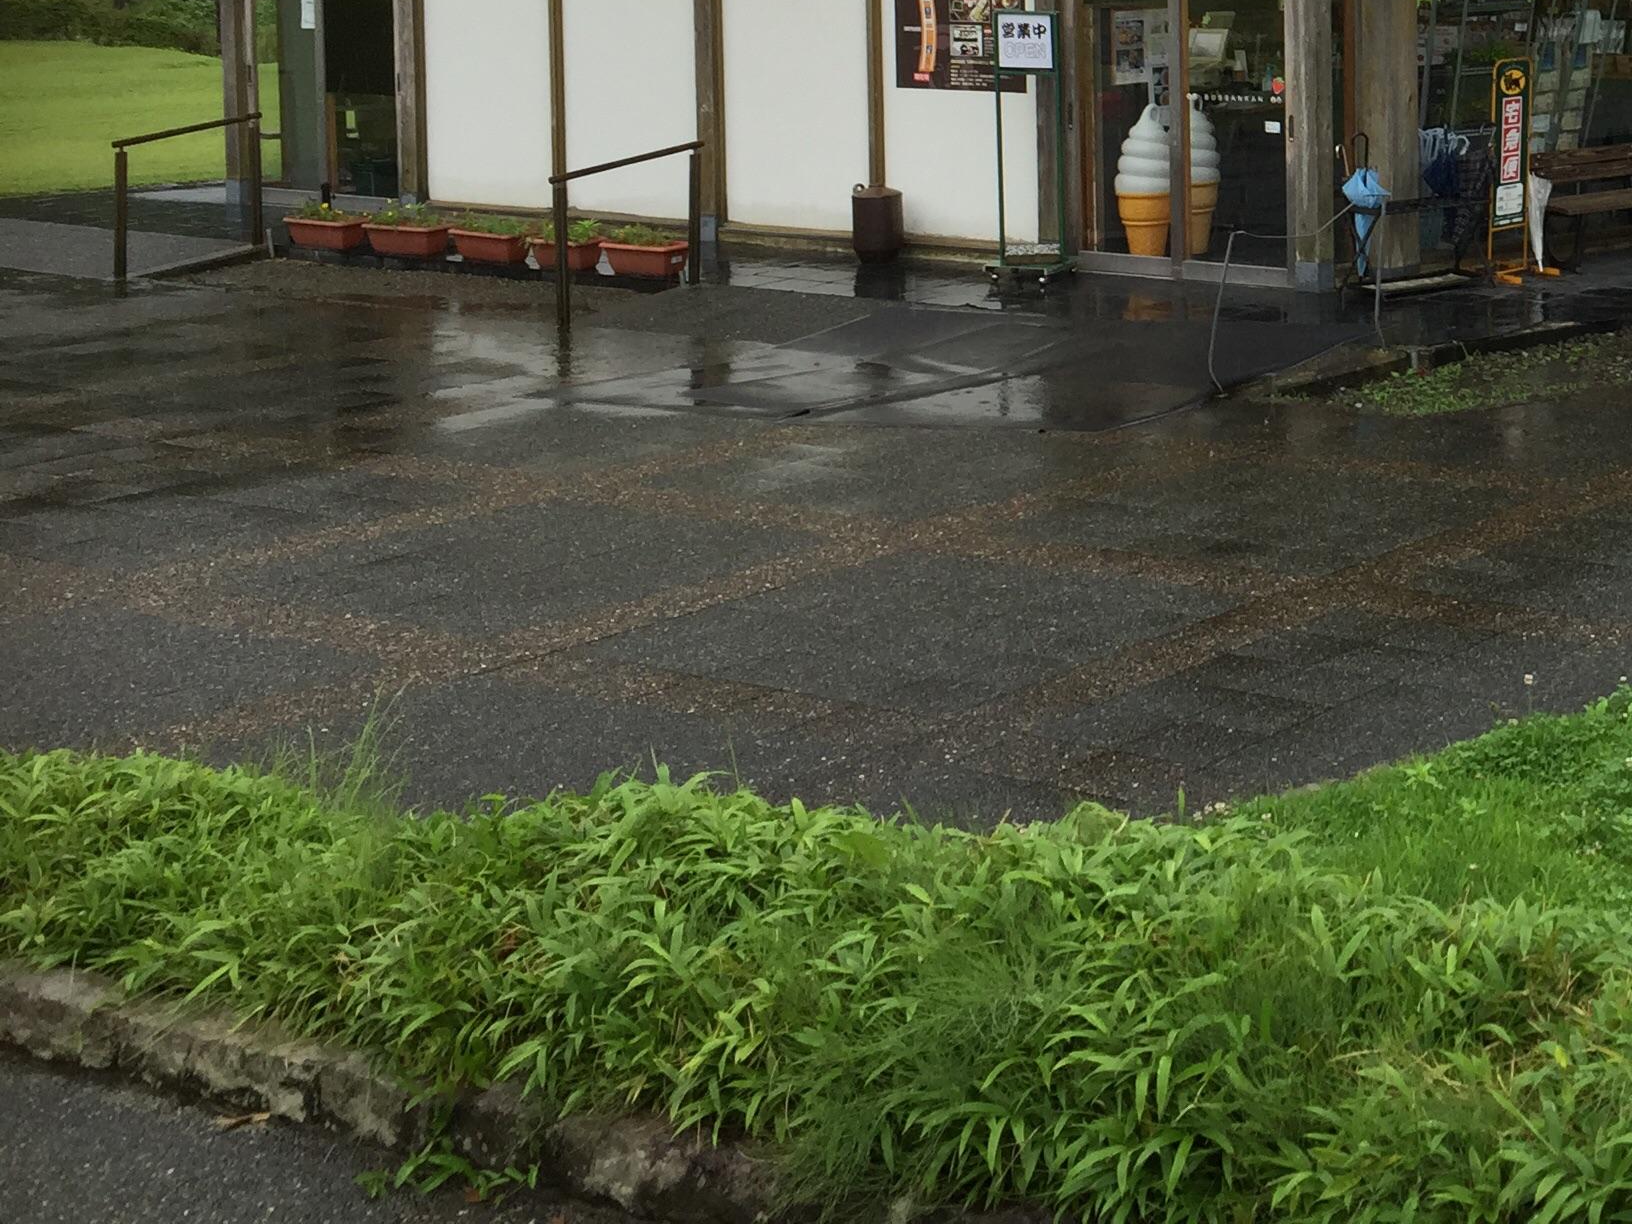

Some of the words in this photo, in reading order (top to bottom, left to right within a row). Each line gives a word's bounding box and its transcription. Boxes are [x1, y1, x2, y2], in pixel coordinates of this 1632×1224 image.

[1002, 22, 1047, 39] 営業中
[1004, 41, 1047, 59] OPEN
[1503, 100, 1521, 180] 宅急便
